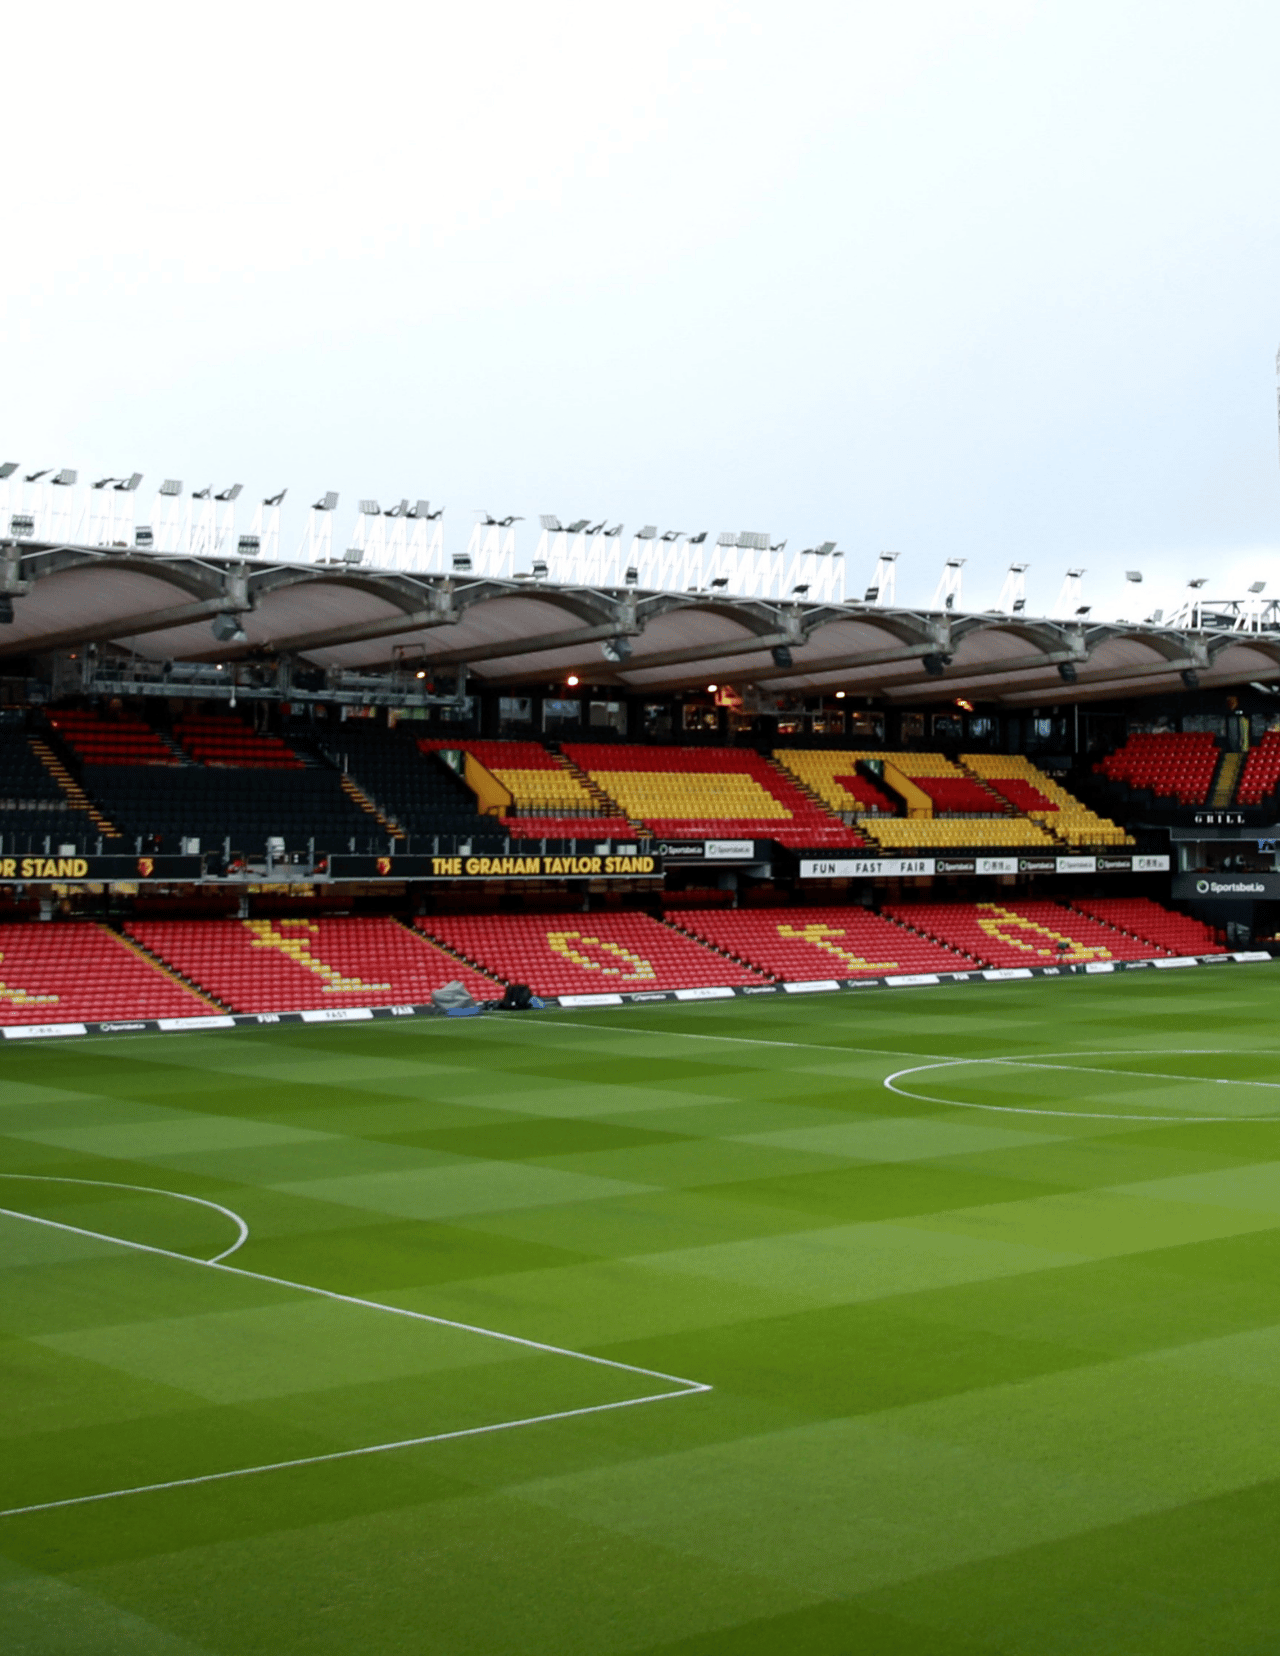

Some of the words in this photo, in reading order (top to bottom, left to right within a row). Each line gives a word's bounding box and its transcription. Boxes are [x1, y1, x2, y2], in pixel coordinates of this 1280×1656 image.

[1194, 814, 1246, 824] GRILL
[21, 858, 88, 877] STAND
[432, 858, 462, 875] THE
[466, 857, 540, 874] GRAHAM
[544, 857, 602, 874] TAYLOR
[605, 857, 654, 873] STAND
[812, 863, 836, 874] FUN
[856, 863, 883, 873] FAST
[900, 862, 926, 872] FAIR
[1210, 882, 1265, 893] Sportsbet.io
